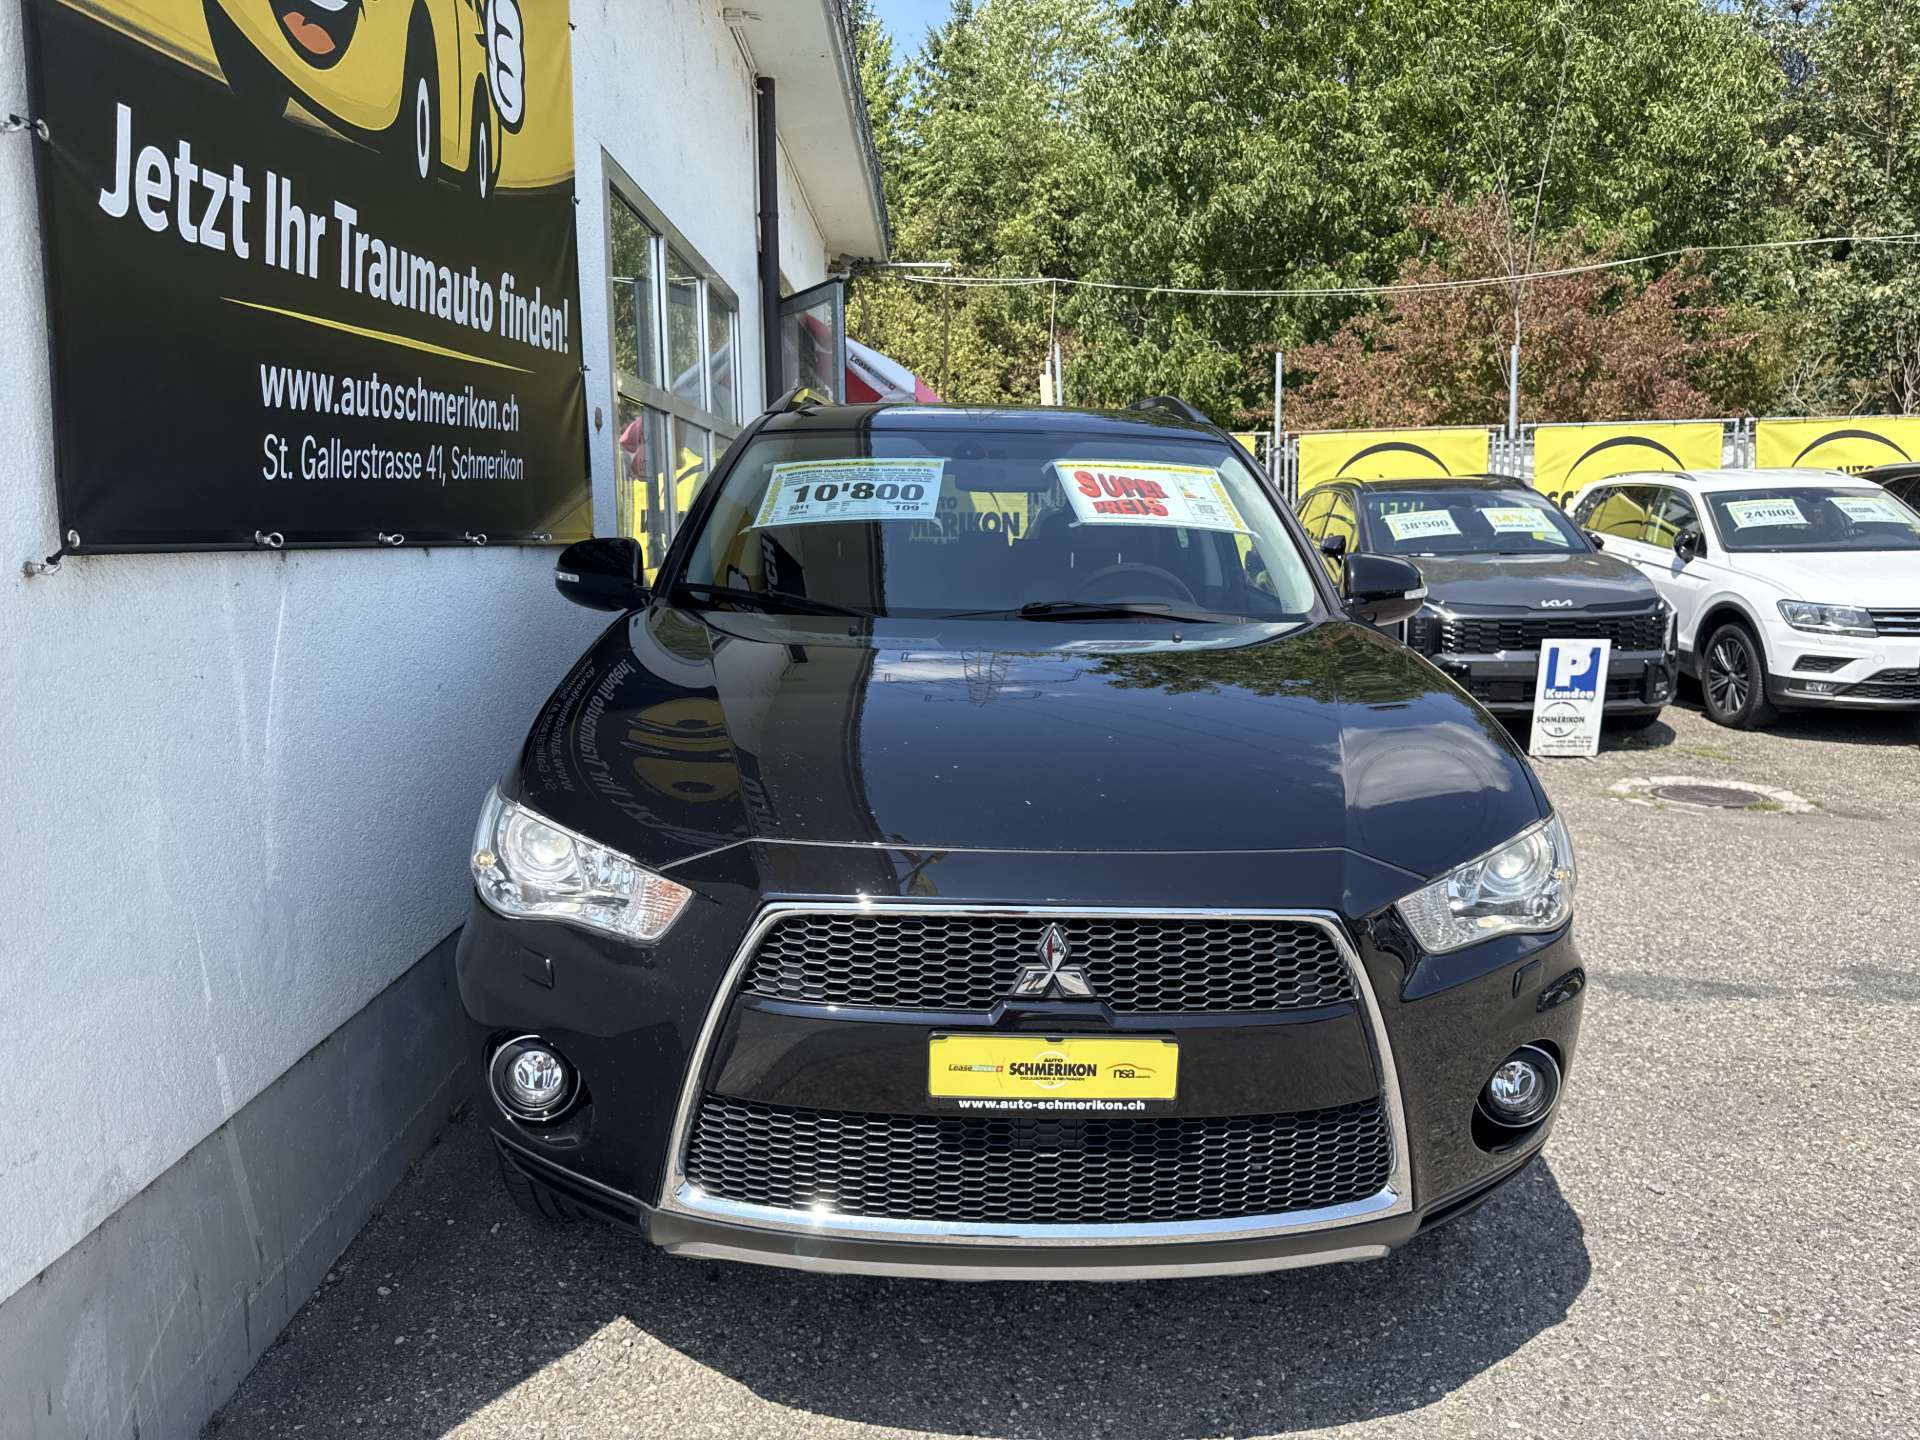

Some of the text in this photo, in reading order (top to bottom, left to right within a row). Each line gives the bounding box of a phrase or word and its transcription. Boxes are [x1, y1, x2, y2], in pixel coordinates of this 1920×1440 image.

[99, 102, 569, 354] Jetzt Ihr Traumauto finden!
[260, 363, 519, 432] www.autoschmerikon.ch
[262, 434, 524, 486] St. Gallerstrasse 41, Schmerikon
[793, 483, 925, 503] 10'800
[1074, 470, 1169, 499] SUPER
[1093, 497, 1168, 516] PREIS
[1554, 647, 1591, 688] P
[1545, 688, 1594, 700] Kunden
[1536, 715, 1585, 724] SCHMERIKON
[1008, 1062, 1097, 1078] SCHMERIKON
[1113, 1068, 1135, 1079] nsa
[958, 1099, 1146, 1111] www.auto-schmerikon.ch
